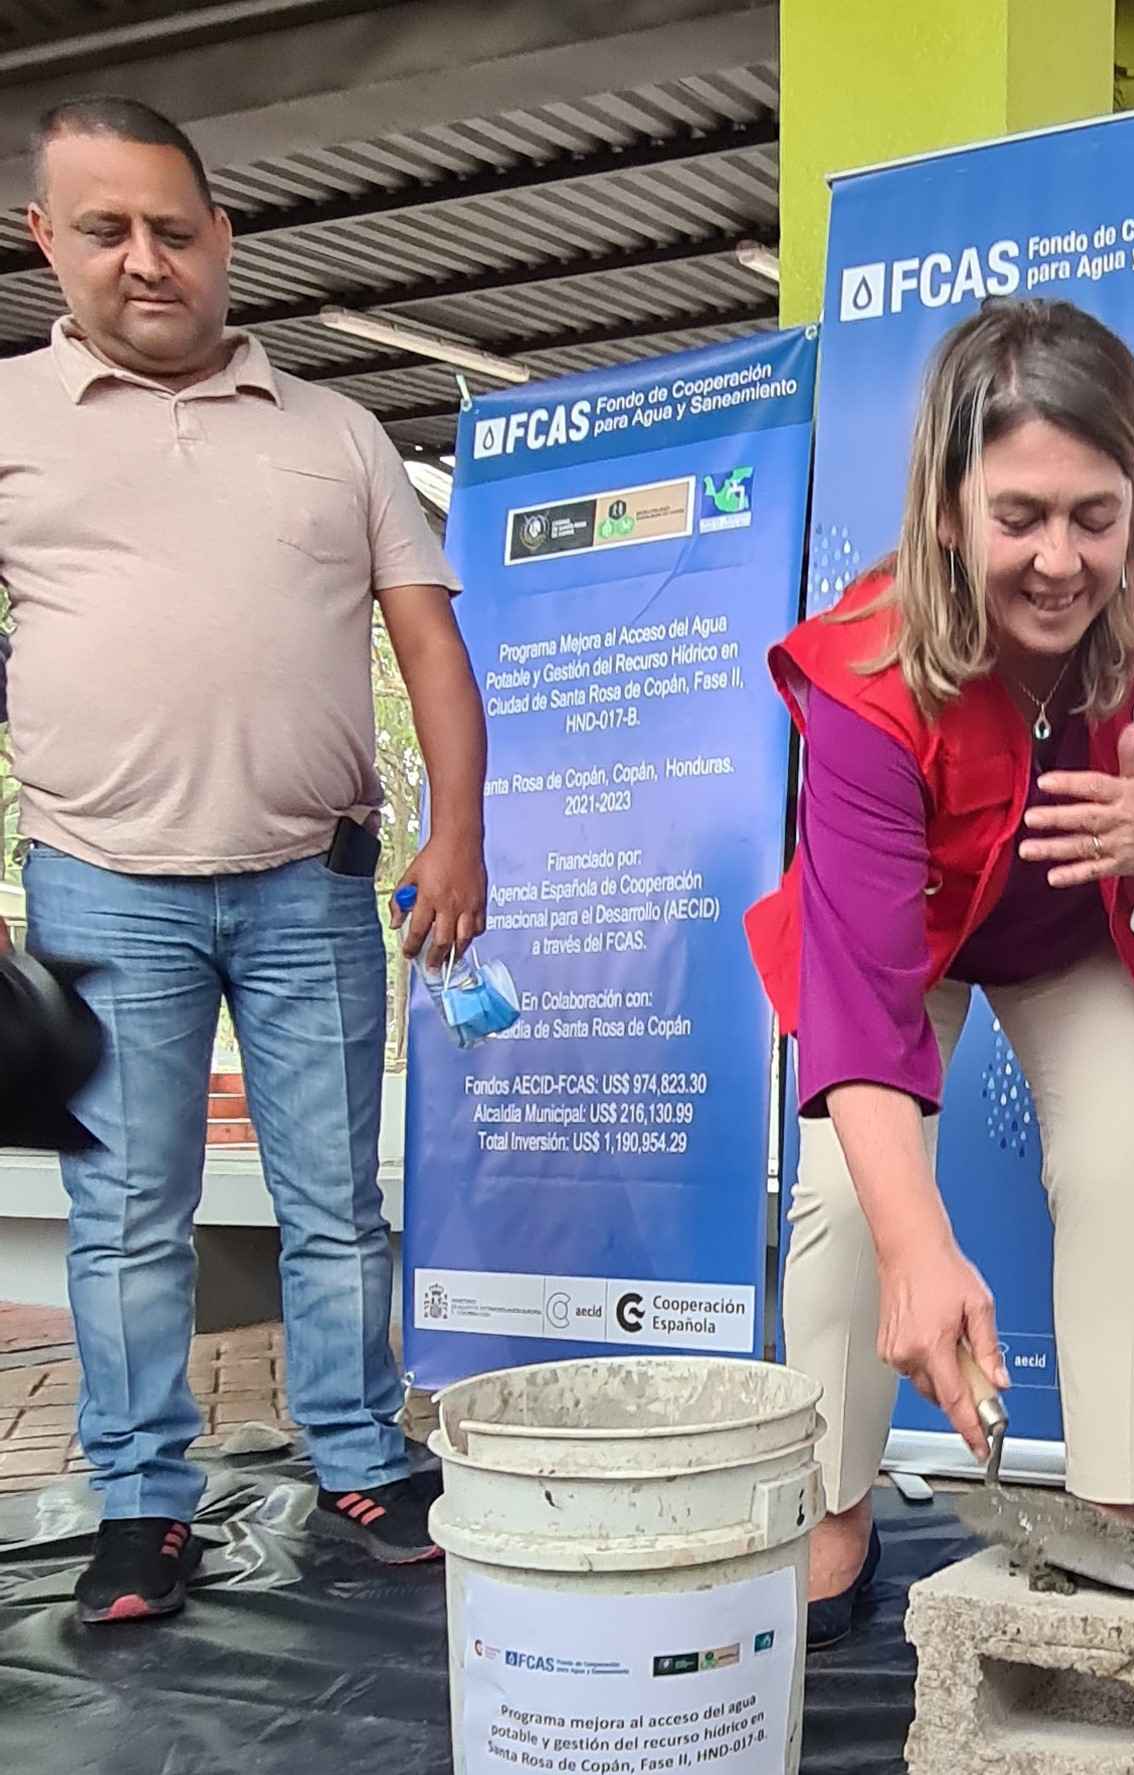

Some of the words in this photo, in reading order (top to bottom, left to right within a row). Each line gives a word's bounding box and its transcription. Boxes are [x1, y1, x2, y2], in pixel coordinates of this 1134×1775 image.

[1027, 231, 1088, 260] Fondo
[1093, 224, 1116, 250] de
[890, 240, 1020, 313] FCAS
[1027, 263, 1070, 290] para
[1077, 250, 1126, 281] Agua
[596, 391, 644, 414] Fondo
[649, 385, 667, 402] de
[672, 362, 772, 399] Cooperación
[594, 415, 628, 436] para
[632, 403, 673, 427] Agua
[676, 404, 686, 420] y
[690, 379, 797, 414] Saneamiento
[505, 400, 591, 454] FCAS
[500, 641, 556, 664] Programa
[560, 633, 601, 655] Mejora
[604, 628, 616, 647] al
[619, 623, 665, 645] Acceso
[668, 617, 689, 637] del
[691, 614, 727, 638] Agua
[486, 669, 530, 691] Potable
[533, 666, 542, 686] y
[544, 659, 590, 682] Gestión
[593, 658, 612, 675] del
[616, 651, 667, 673] Recurso
[721, 642, 738, 660] en
[487, 694, 529, 717] Ciudad
[531, 693, 547, 711] de
[550, 687, 586, 709] Santa
[589, 683, 622, 704] Rosa
[624, 681, 640, 699] de
[644, 675, 690, 699] Copán,
[694, 670, 728, 690] Fase
[566, 707, 640, 733] HND-017-B.
[483, 777, 509, 797] anta
[512, 773, 544, 793] Rosa
[546, 770, 562, 790] de
[565, 764, 609, 789] Copán,
[612, 760, 658, 785] Copán,
[665, 755, 734, 776] Honduras.
[564, 791, 631, 816] 2021-2023
[547, 849, 614, 872] Financiado
[488, 883, 538, 907] Agencia
[541, 878, 597, 904] Española
[600, 877, 616, 896] de
[620, 870, 702, 896] Cooperación
[486, 907, 547, 931] ernacional
[550, 909, 578, 931] para
[581, 905, 593, 925] el
[595, 899, 660, 923] Desarrollo
[663, 897, 721, 924] (AECID)
[532, 942, 540, 955] a
[543, 935, 580, 955] través
[583, 934, 603, 953] del
[606, 930, 647, 951] FCAS.
[521, 991, 538, 1012] En
[542, 988, 622, 1011] Colaboración
[625, 991, 653, 1008] con:
[534, 1019, 550, 1039] de
[553, 1019, 589, 1038] Santa
[592, 1016, 625, 1038] Rosa
[628, 1016, 645, 1036] de
[647, 1013, 691, 1040] Copán
[464, 1075, 510, 1096] Fondos
[511, 1074, 599, 1095] AECID-FCAS:
[602, 1073, 630, 1095] US$
[632, 1072, 708, 1097] 974,823.30
[524, 1103, 586, 1127] Municipal:
[589, 1102, 617, 1124] US$
[620, 1102, 693, 1126] 216,130.99
[477, 1130, 508, 1150] Total
[511, 1131, 570, 1152] Inversión:
[573, 1131, 600, 1153] US$
[575, 1305, 602, 1319] aecid
[652, 1295, 746, 1320] Cooperación
[652, 1317, 716, 1335] Española
[1015, 1354, 1046, 1368] aecid
[518, 1653, 554, 1672] FCAS
[501, 1704, 565, 1728] Programa
[570, 1716, 625, 1732] mejora
[630, 1715, 643, 1729] al
[648, 1711, 699, 1728] acceso
[703, 1703, 724, 1720] del
[728, 1695, 756, 1714] agua
[491, 1725, 538, 1745] potable
[542, 1737, 551, 1749] y
[554, 1737, 610, 1751] gestión
[614, 1736, 638, 1750] del
[643, 1732, 700, 1749] recurso
[704, 1719, 748, 1741] hídrico
[751, 1711, 765, 1725] en
[488, 1740, 518, 1762] Santa
[521, 1752, 554, 1769] Rosa
[558, 1757, 576, 1771] de
[581, 1759, 635, 1775] Copán,
[640, 1757, 673, 1771] Fase
